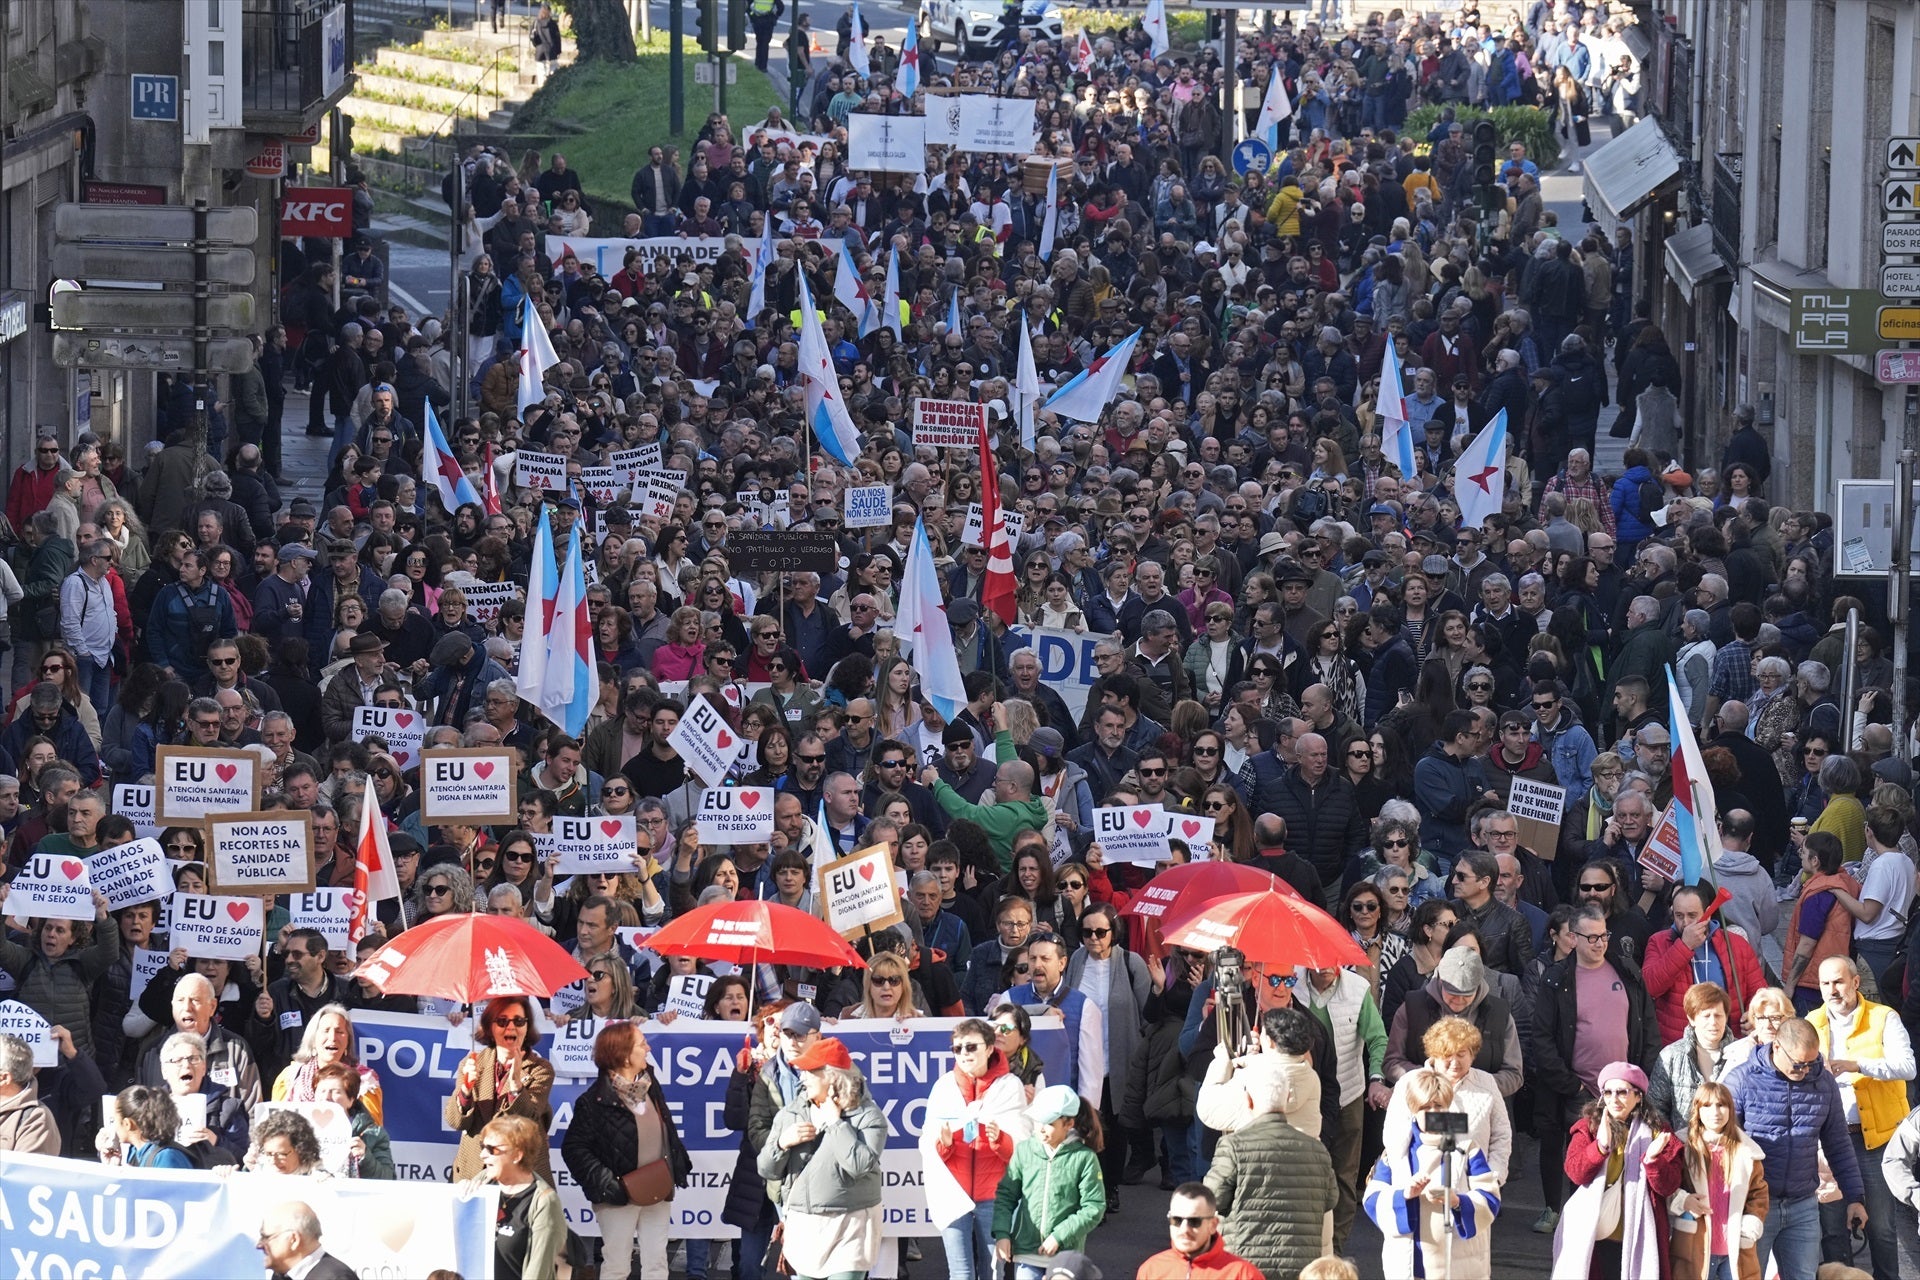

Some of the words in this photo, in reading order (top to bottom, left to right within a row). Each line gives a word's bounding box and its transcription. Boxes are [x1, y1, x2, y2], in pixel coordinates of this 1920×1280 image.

[139, 81, 170, 104] PR
[281, 202, 345, 223] KFC
[1886, 240, 1906, 248] DOS
[1886, 273, 1914, 281] HOTEL
[1886, 285, 1898, 293] AC
[920, 401, 981, 416] URXENCIAS
[922, 413, 936, 425] EN
[938, 413, 979, 428] MOAÑA
[915, 424, 929, 432] NON
[928, 426, 951, 434] SOMOS
[951, 427, 980, 436] CULPABL
[915, 433, 967, 445] SOLUCIÓN
[518, 452, 565, 465] URXENCIAS
[612, 444, 659, 461] URXENCIAS
[616, 463, 627, 471] EN
[628, 456, 659, 469] MOAÑA
[519, 464, 530, 472] EN
[530, 465, 563, 476] MOAÑA
[851, 489, 866, 498] COA
[867, 488, 886, 498] NOSA
[846, 509, 862, 518] NON
[863, 508, 872, 517] SE
[873, 507, 891, 517] XOGA
[971, 506, 1022, 525] URCIAS
[969, 518, 981, 529] EN
[362, 709, 388, 728] EU
[692, 704, 717, 734] EU
[398, 732, 422, 741] SAÚDE
[680, 730, 695, 749] DIGNA
[175, 762, 206, 782] EU
[436, 762, 465, 782] EU
[167, 785, 207, 795] ATENCIÓN
[208, 787, 249, 796] SANITARIA
[429, 784, 466, 793] ATENCIÓN
[467, 784, 506, 792] SANITARIA
[1519, 783, 1528, 793] LA
[1529, 786, 1563, 801] SANIDAD
[123, 788, 150, 807] EU
[175, 795, 201, 803] DIGNA
[214, 796, 240, 805] MARÍN
[437, 794, 460, 802] DIGNA
[462, 793, 473, 801] EN
[474, 793, 498, 801] MARÍN
[704, 791, 731, 810] EU
[1512, 793, 1524, 803] NO
[1524, 795, 1534, 806] SE
[116, 809, 152, 818] ATENCIÓN
[1510, 804, 1521, 814] SE
[697, 813, 731, 822] CENTRO
[732, 814, 743, 822] DE
[746, 811, 773, 821] SAÚDE
[1101, 811, 1126, 832] EU
[231, 826, 259, 837] NON
[262, 825, 287, 836] AOS
[563, 821, 591, 840] EU
[717, 823, 729, 831] EN
[731, 823, 757, 831] SEIXO
[1097, 833, 1128, 843] ATENCIÓN
[1129, 831, 1166, 840] PEDIÁTRICA
[220, 840, 280, 851] RECORTES
[283, 839, 300, 849] NA
[557, 843, 588, 852] CENTRO
[594, 844, 605, 852] DE
[607, 841, 636, 850] SAÚDE
[1105, 842, 1127, 851] DIGNA
[1128, 841, 1138, 849] EN
[1138, 840, 1160, 849] MARÍN
[92, 854, 117, 870] NON
[120, 844, 144, 859] AOS
[143, 853, 160, 866] NA
[231, 853, 291, 865] SANIDADE
[578, 853, 591, 861] EN
[592, 853, 619, 861] SEIXO
[19, 858, 51, 879] EU
[237, 865, 287, 878] PÚBLICA
[10, 882, 48, 893] CENTRO
[50, 884, 62, 893] DE
[100, 869, 155, 895] SANIDADE
[832, 868, 856, 895] EU
[33, 893, 47, 903] EN
[48, 894, 76, 904] SEIXO
[108, 883, 155, 905] PÚBLICA
[302, 892, 332, 912] EU
[183, 898, 217, 921] EU
[838, 905, 857, 916] DIGNA
[293, 916, 333, 924] ATENCIÓN
[174, 922, 213, 935] CENTRO
[215, 926, 228, 935] DE
[230, 926, 261, 937] SAÚDE
[197, 935, 210, 944] EN
[212, 935, 242, 946] SEIXO
[681, 977, 712, 999] EU
[554, 992, 584, 1002] ATENCIÓN
[670, 997, 703, 1011] ATENCIÓ
[677, 1008, 701, 1020] DIGNA
[565, 1020, 596, 1039] EU
[557, 1044, 593, 1053] ATENCIÓN
[359, 1036, 460, 1079] POL
